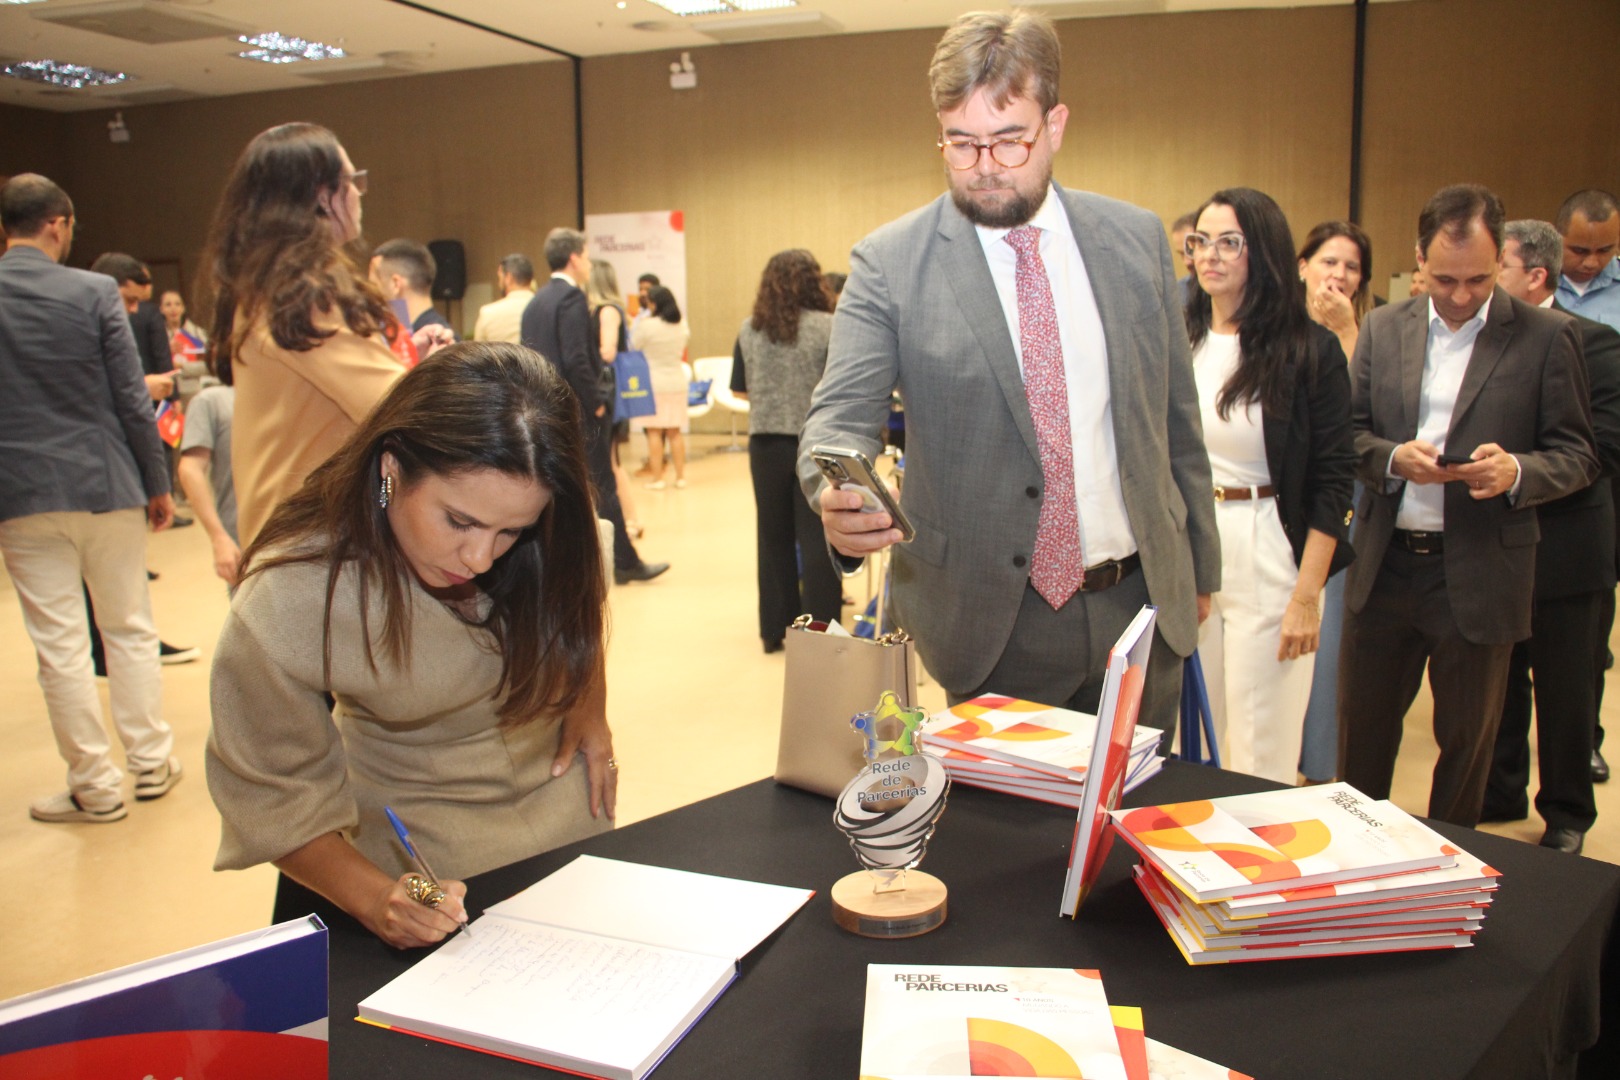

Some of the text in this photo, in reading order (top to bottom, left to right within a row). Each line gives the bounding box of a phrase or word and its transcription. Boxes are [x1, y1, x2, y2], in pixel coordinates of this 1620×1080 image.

[872, 760, 910, 774] Rede
[882, 775, 901, 786] de
[857, 786, 927, 803] Parcerias
[1333, 791, 1364, 806] REDE
[1327, 796, 1383, 827] PARCERIAS
[894, 974, 941, 982] REDE
[906, 982, 1009, 993] PARCERIAS
